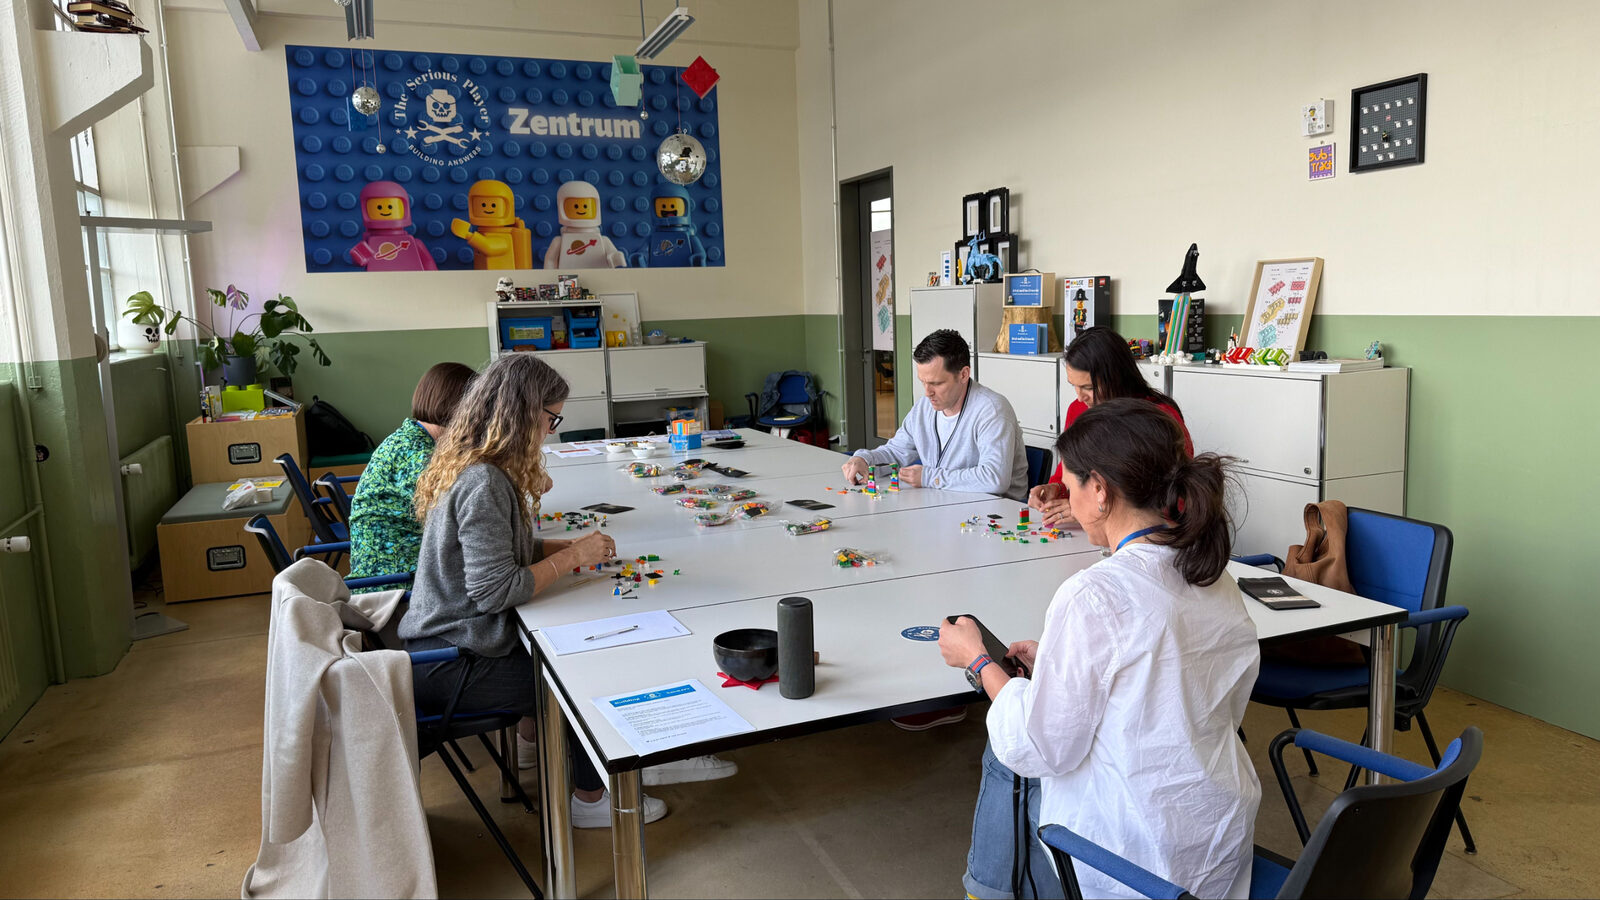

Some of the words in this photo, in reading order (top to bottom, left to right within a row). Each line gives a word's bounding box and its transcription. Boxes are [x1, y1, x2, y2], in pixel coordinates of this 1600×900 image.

[394, 93, 409, 120] The
[405, 69, 458, 91] Serious
[462, 79, 489, 123] Player
[508, 107, 640, 138] Zentrum
[408, 144, 445, 166] BUILDING
[447, 145, 482, 167] ANSWERS
